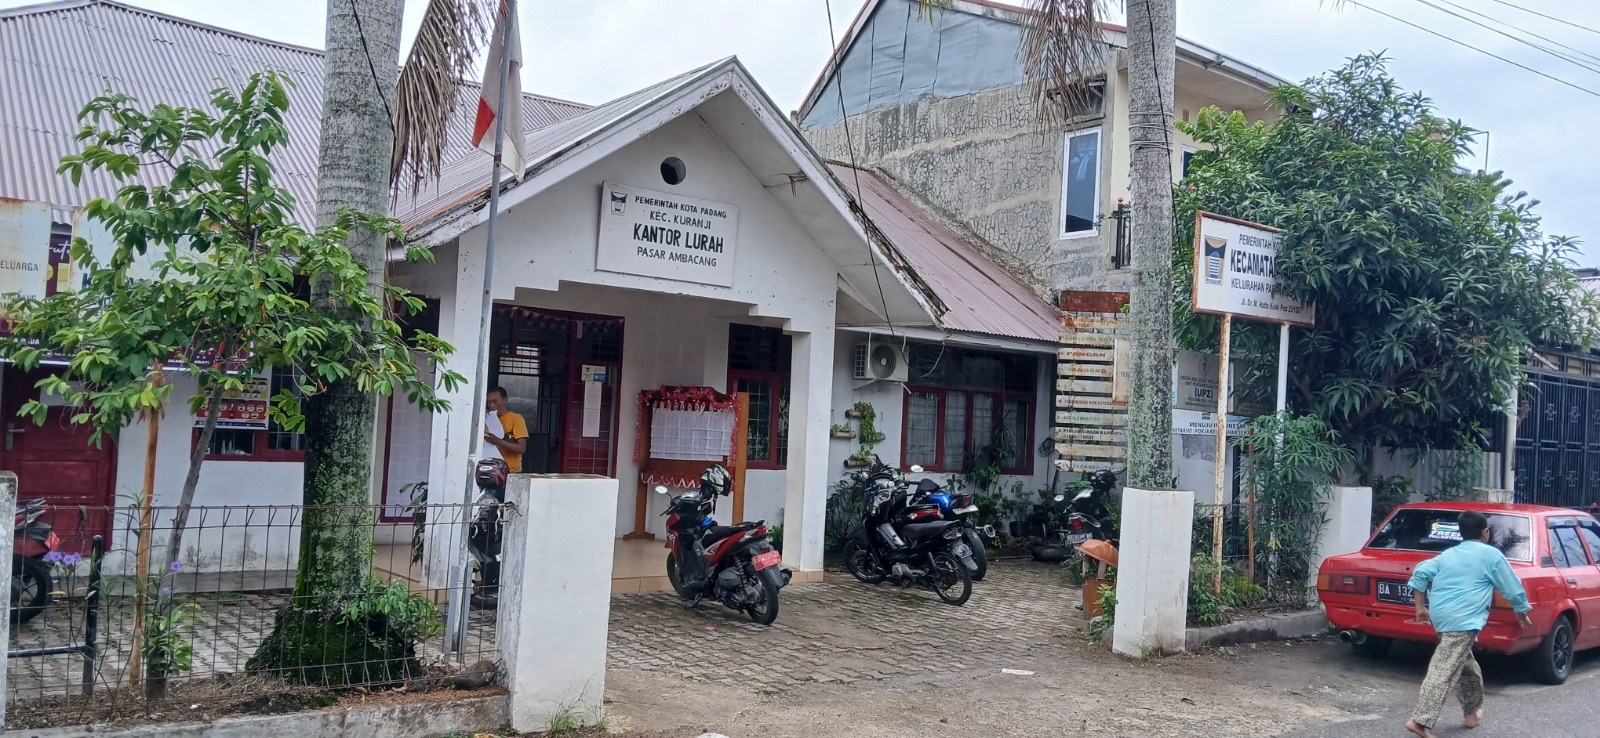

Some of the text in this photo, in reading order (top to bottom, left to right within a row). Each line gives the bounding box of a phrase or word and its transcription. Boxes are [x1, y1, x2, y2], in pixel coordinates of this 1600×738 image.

[635, 195, 727, 219] PEMERINTAH KOTA PADANG
[649, 210, 712, 230] KEC. KURANJI
[633, 222, 724, 254] KANTOR LURAH
[1238, 233, 1287, 253] PEMERINTAH KOT
[637, 246, 717, 267] PASAR AMBACANG
[0, 260, 39, 272] ELUARGA
[1231, 277, 1265, 293] KELURAHAN
[1194, 387, 1214, 400] (UPZ)
[1189, 421, 1213, 429] MENUJU
[1379, 583, 1390, 595] BA
